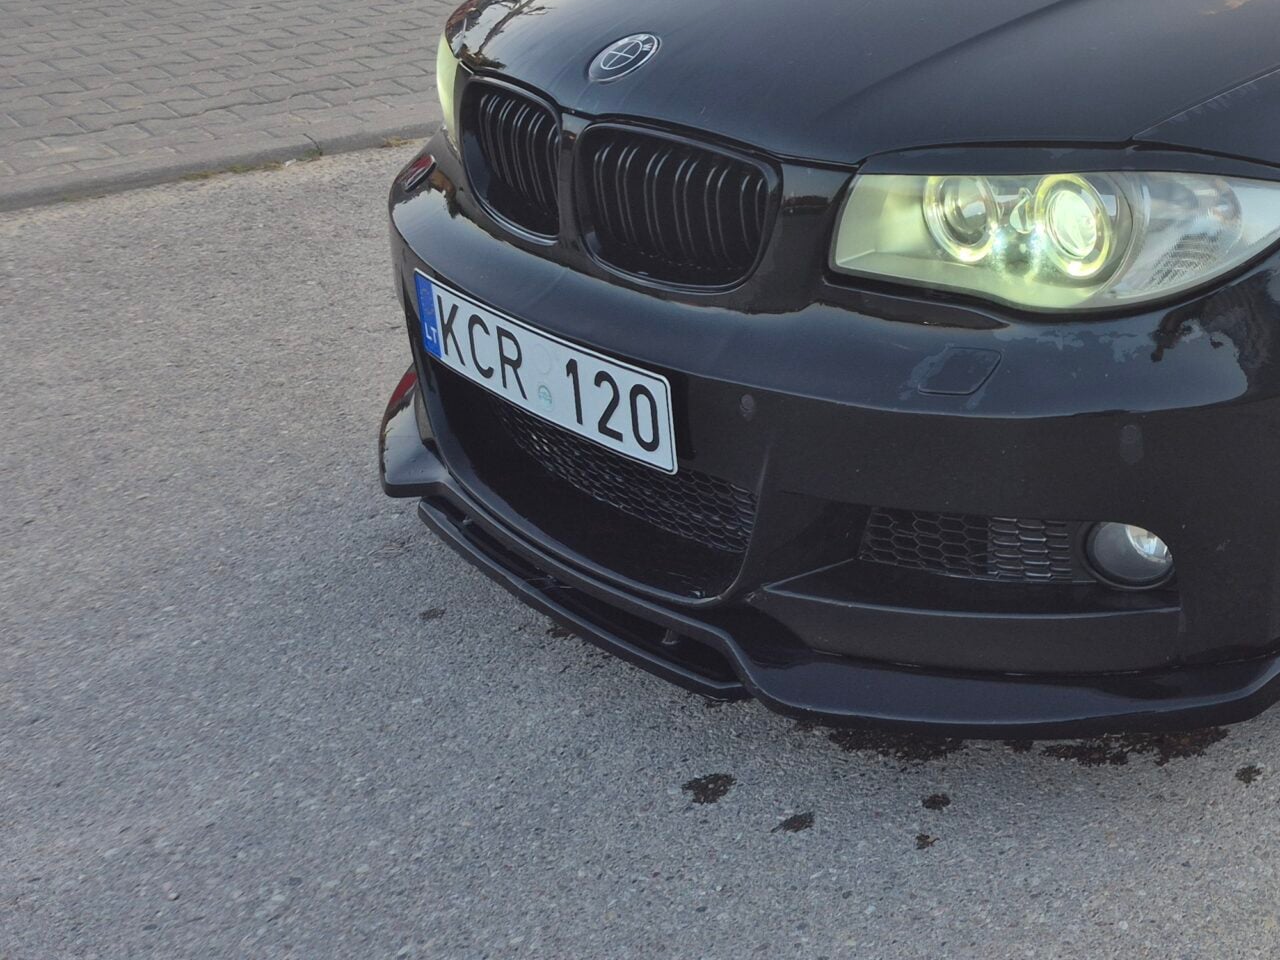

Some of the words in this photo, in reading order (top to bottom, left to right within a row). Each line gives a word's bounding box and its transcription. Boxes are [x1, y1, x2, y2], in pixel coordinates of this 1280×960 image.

[425, 325, 438, 344] LT
[437, 294, 527, 400] KCR
[566, 358, 660, 451] 120
